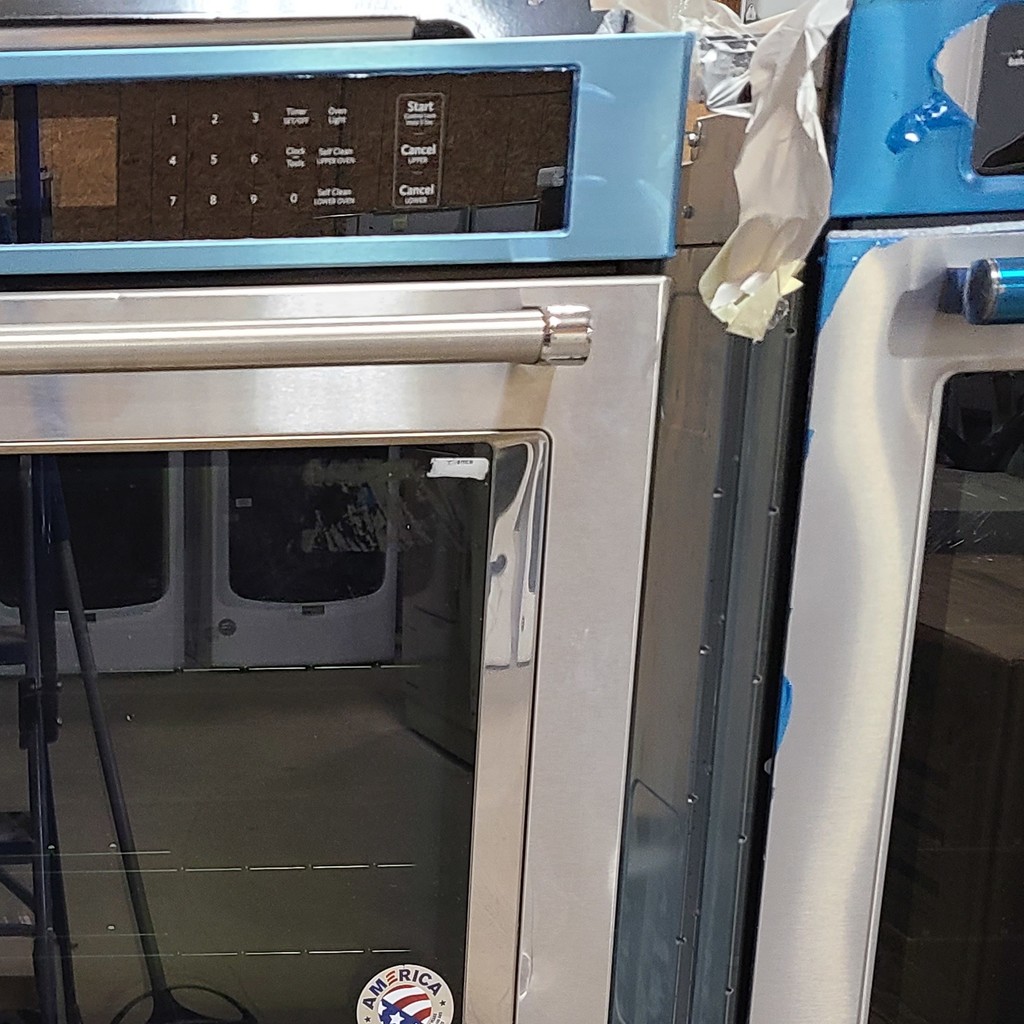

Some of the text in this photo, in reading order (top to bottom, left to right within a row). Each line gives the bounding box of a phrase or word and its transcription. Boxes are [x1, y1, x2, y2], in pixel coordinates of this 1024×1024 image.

[407, 101, 435, 112] Start
[170, 115, 176, 125] 1
[211, 114, 219, 125] 2
[252, 113, 259, 123] 3
[400, 143, 437, 156] Cancel
[169, 155, 176, 166] 4
[210, 154, 218, 165] 5
[250, 154, 258, 164] 6
[399, 184, 435, 196] Cancel
[170, 196, 176, 206] 7
[209, 195, 218, 205] 8
[250, 193, 258, 204] 9
[290, 193, 298, 204] 0
[362, 969, 442, 1010] AMERICA
